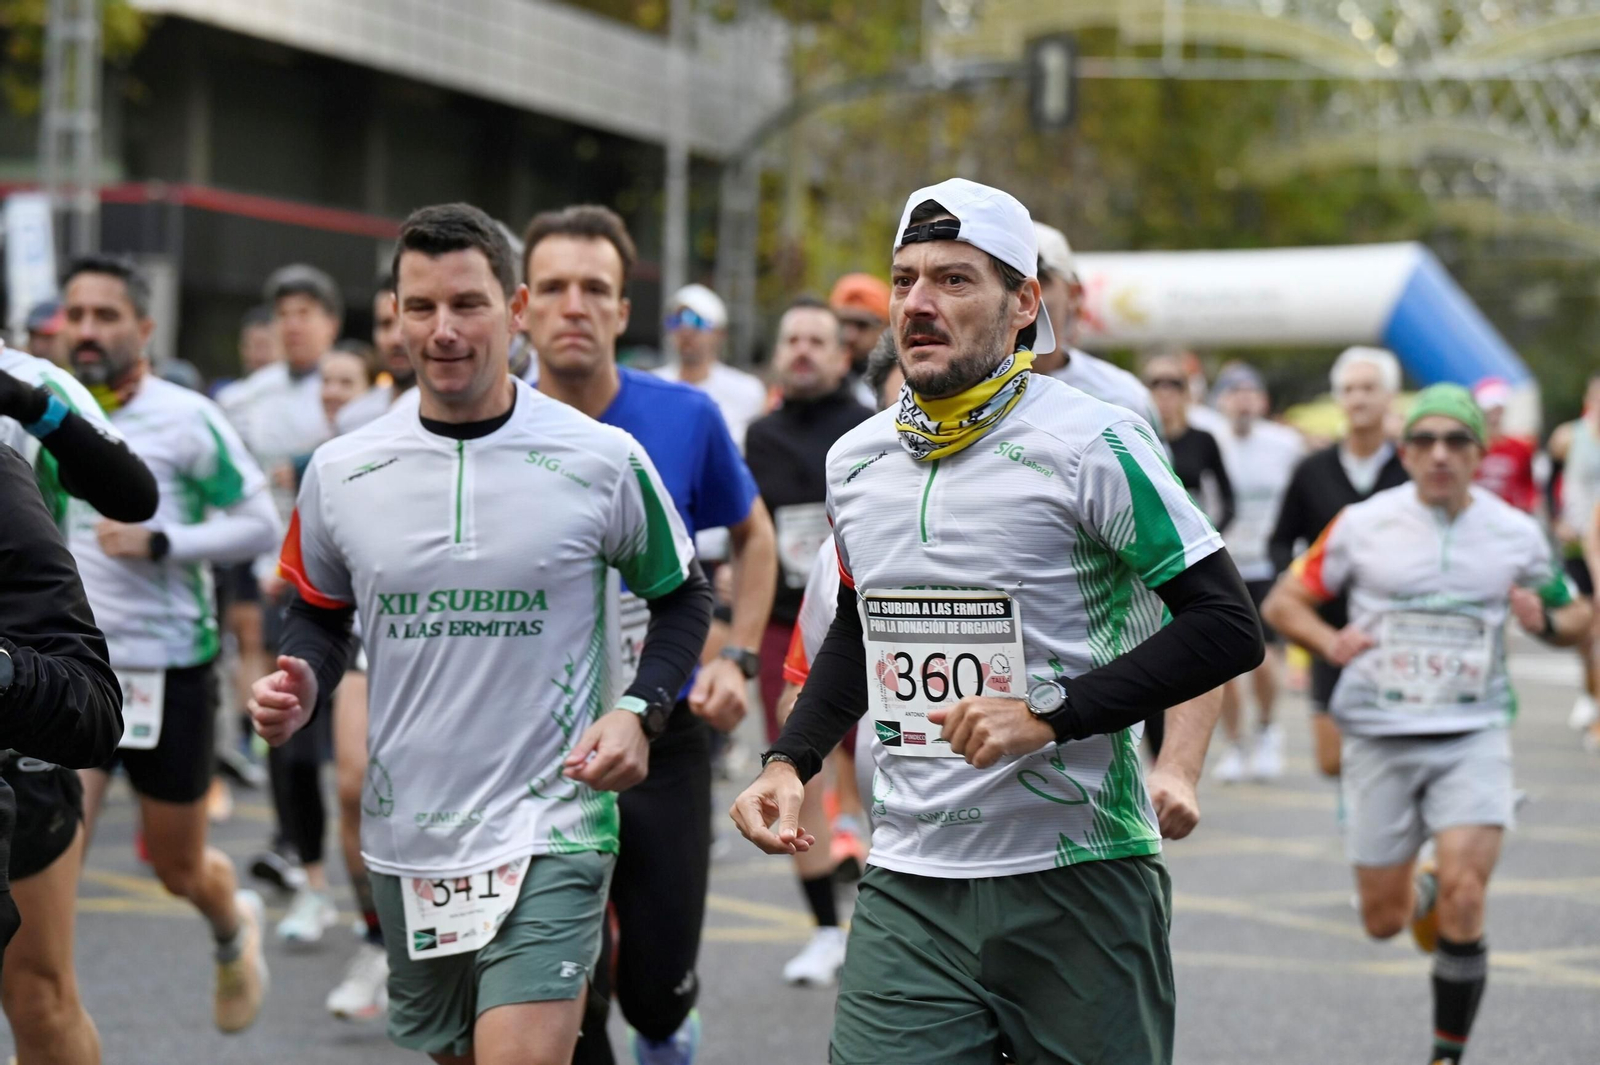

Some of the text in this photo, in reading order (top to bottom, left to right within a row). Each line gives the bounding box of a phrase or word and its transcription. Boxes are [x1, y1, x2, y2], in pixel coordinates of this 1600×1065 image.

[524, 450, 561, 472] SIG
[994, 441, 1054, 478] SIG Laboral
[377, 589, 549, 615] XII SUBIDA
[867, 601, 1005, 616] XII SUBIDA A LAS ERMITAS
[387, 619, 544, 638] A LAS ERMITAS
[870, 620, 1011, 635] POR LA DONACIÓN DE ORGANOS
[894, 651, 984, 702] 360
